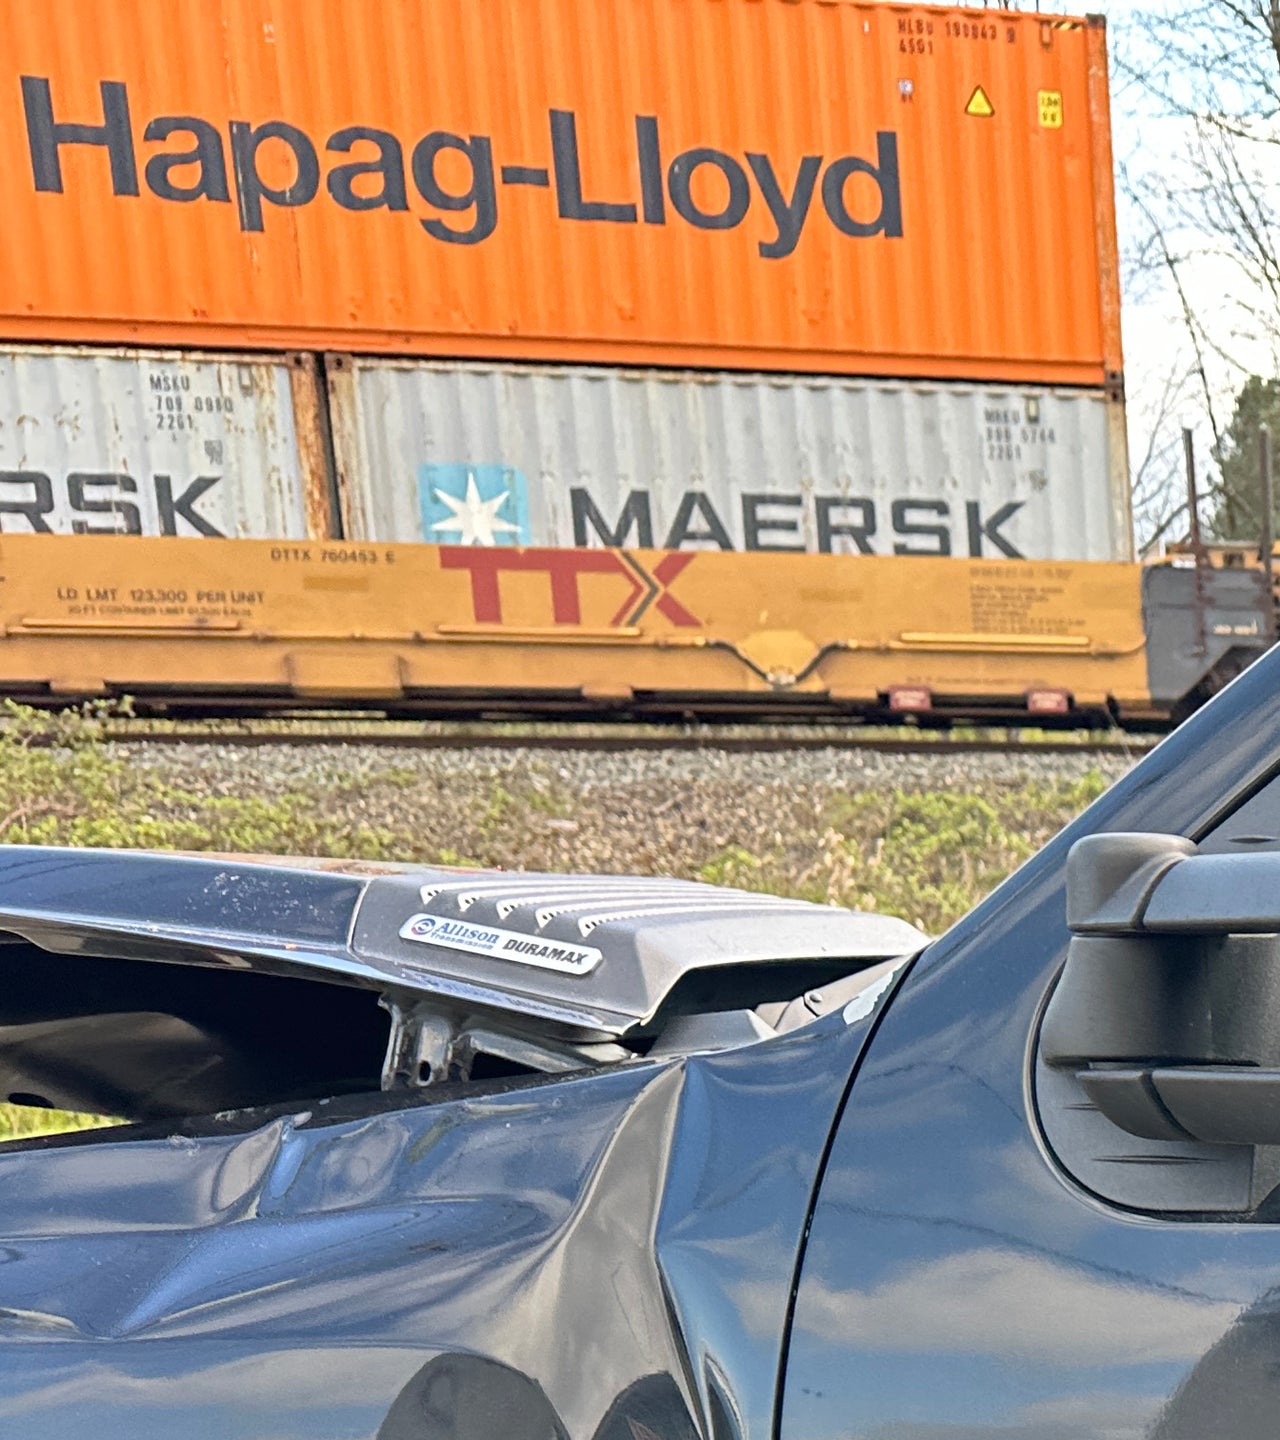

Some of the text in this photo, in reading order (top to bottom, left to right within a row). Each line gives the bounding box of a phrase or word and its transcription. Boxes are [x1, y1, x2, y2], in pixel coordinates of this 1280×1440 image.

[19, 74, 904, 259] Hapag-Lloyd
[149, 373, 190, 391] MSKU
[569, 486, 1028, 560] MAERSK
[270, 547, 311, 562] DTTX
[438, 545, 702, 628] TTX
[435, 921, 500, 944] Allison
[502, 938, 589, 966] DURAMAX
